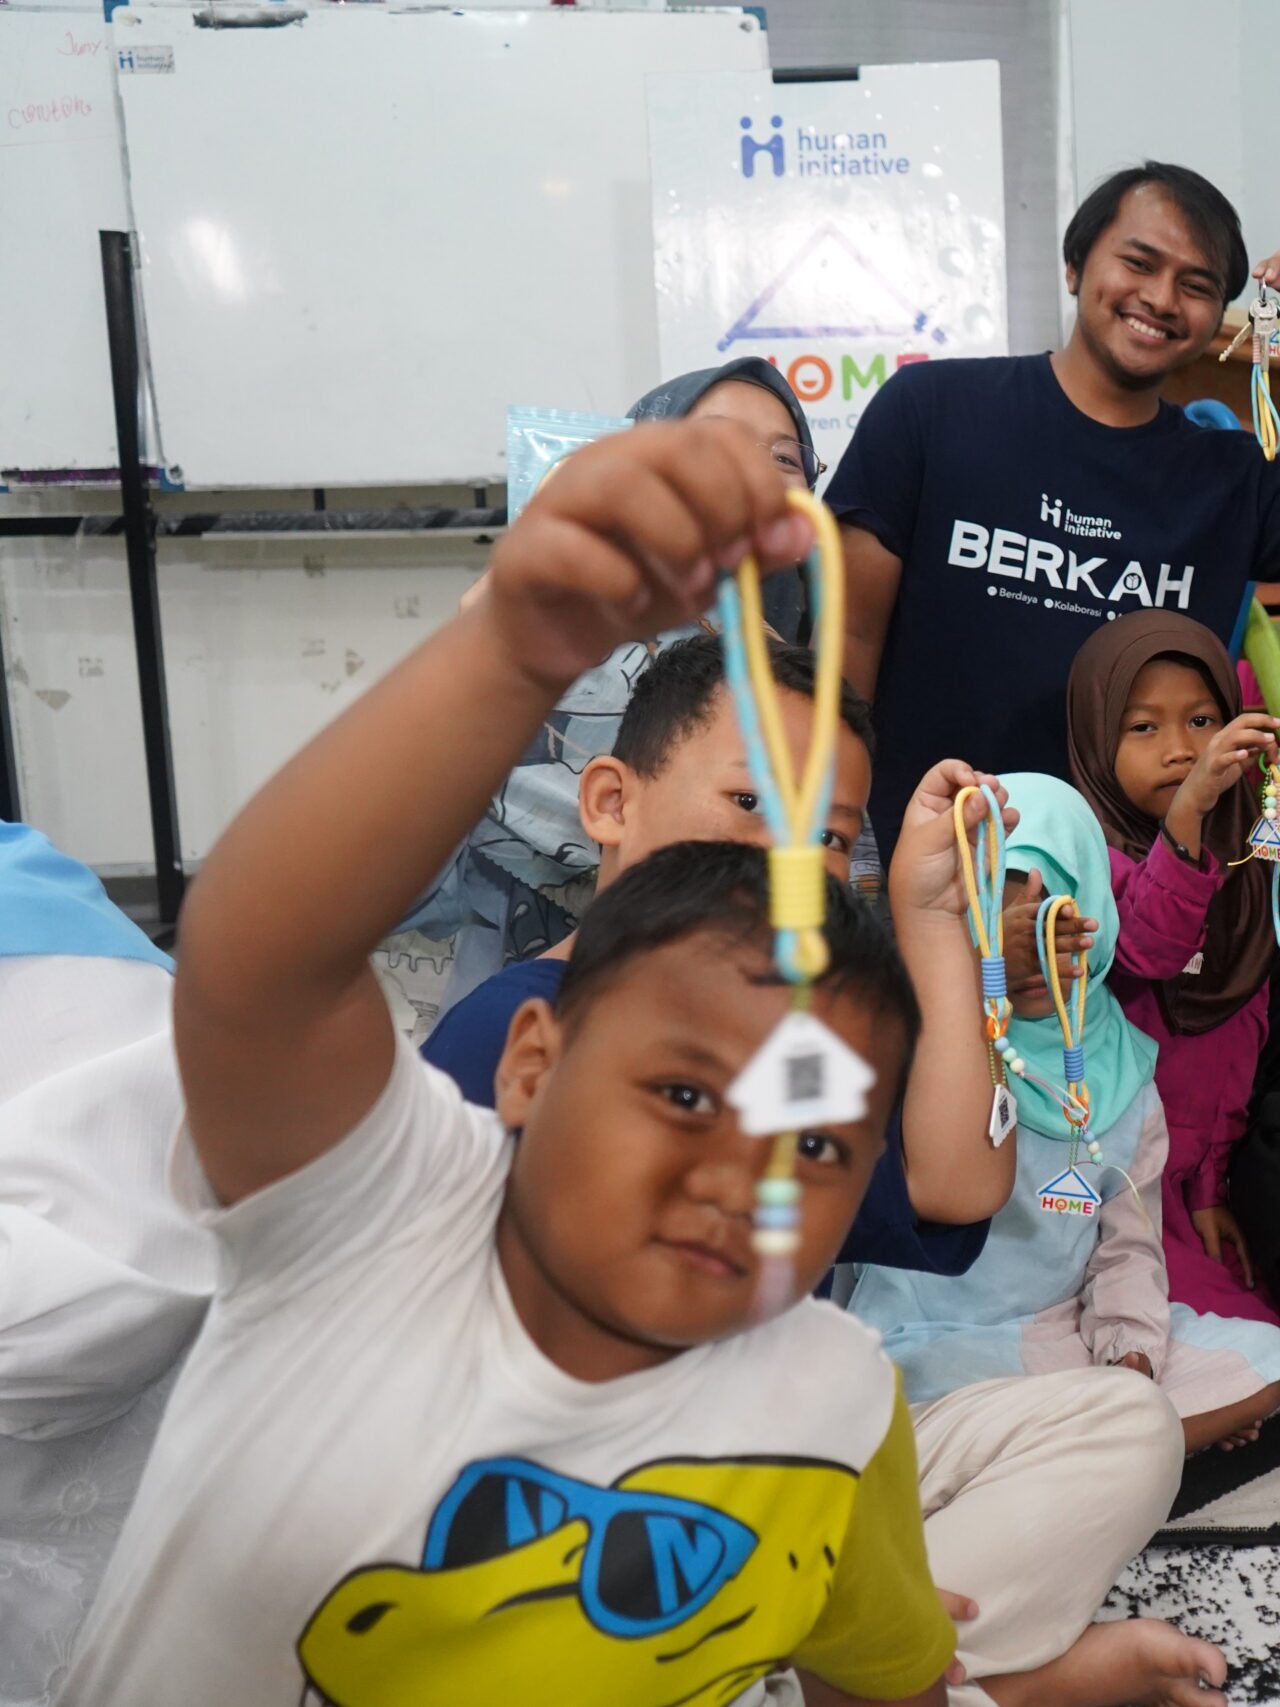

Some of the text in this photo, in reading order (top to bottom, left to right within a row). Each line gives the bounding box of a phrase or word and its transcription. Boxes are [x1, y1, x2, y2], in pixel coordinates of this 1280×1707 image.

[768, 353, 930, 402] OM
[1064, 520, 1122, 540] initiative
[1065, 508, 1112, 528] human
[947, 519, 1195, 610] BERKAH
[998, 587, 1102, 618] Berdaya Kolaborasi
[1042, 1196, 1093, 1214] HOME
